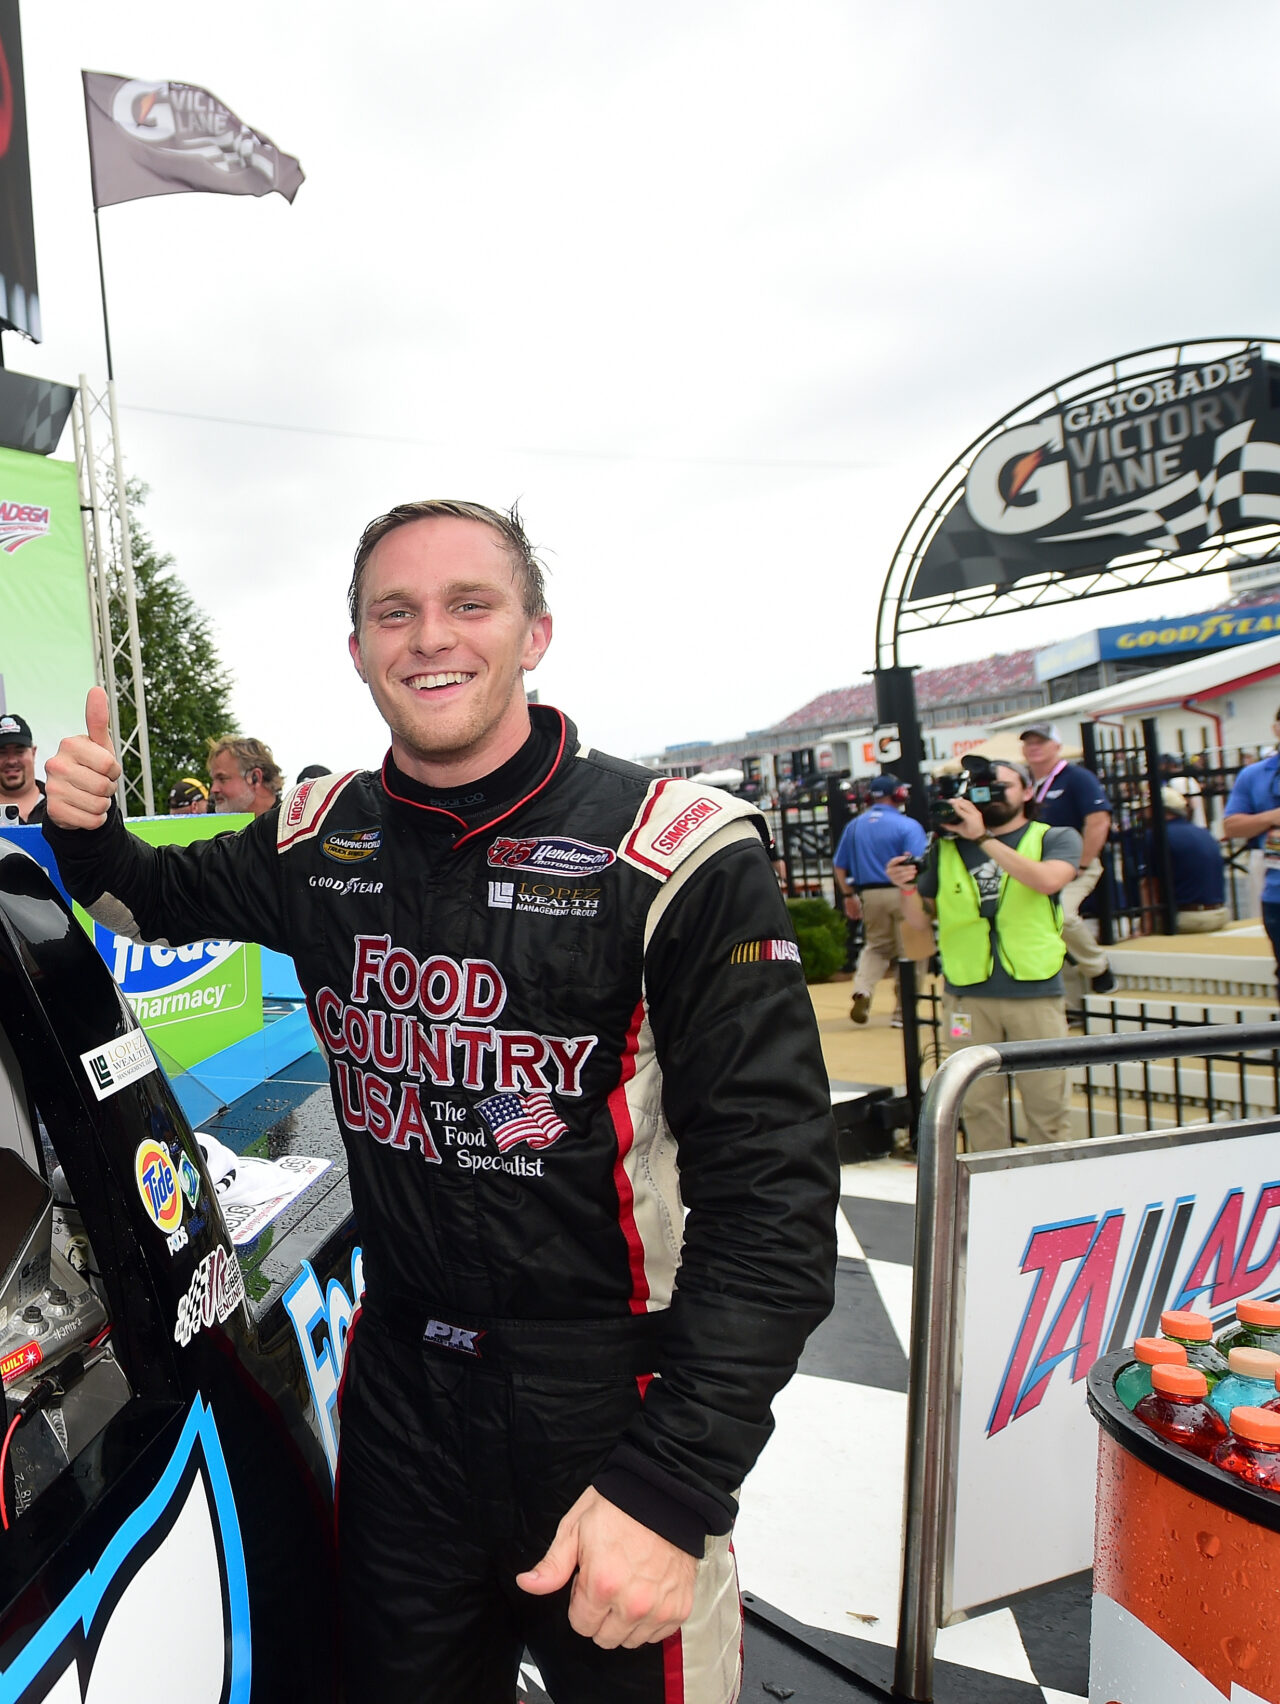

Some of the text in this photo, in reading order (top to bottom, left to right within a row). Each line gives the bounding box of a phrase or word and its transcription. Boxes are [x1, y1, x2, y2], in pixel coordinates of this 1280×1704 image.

[175, 110, 229, 136] LANE
[1064, 353, 1253, 432] GATORADE
[1067, 384, 1253, 469] VICTORY
[1073, 445, 1185, 505] LANE
[659, 801, 715, 851] SIMPSON
[329, 836, 363, 849] CAMPING
[489, 839, 536, 867] 75
[532, 843, 608, 863] Henderson
[534, 859, 604, 872] MOTORSPORTS
[309, 876, 384, 896] GOODYEAR
[520, 883, 600, 900] LOPEZ
[516, 903, 597, 918] MANAGEMENT GROUP
[517, 894, 600, 909] WEALTH
[771, 939, 801, 964] NAS
[350, 934, 507, 1022] FOOD
[108, 1035, 146, 1062] LOPEZ
[316, 986, 599, 1096] COUNTRY
[112, 1046, 150, 1070] WEALTH
[334, 1060, 442, 1164] USA
[431, 1100, 467, 1122] The
[443, 1125, 487, 1147] Food
[457, 1149, 545, 1177] Specialist
[143, 1158, 175, 1221] Tide
[984, 1180, 1280, 1440] TALLAD
[424, 1319, 478, 1350] PK
